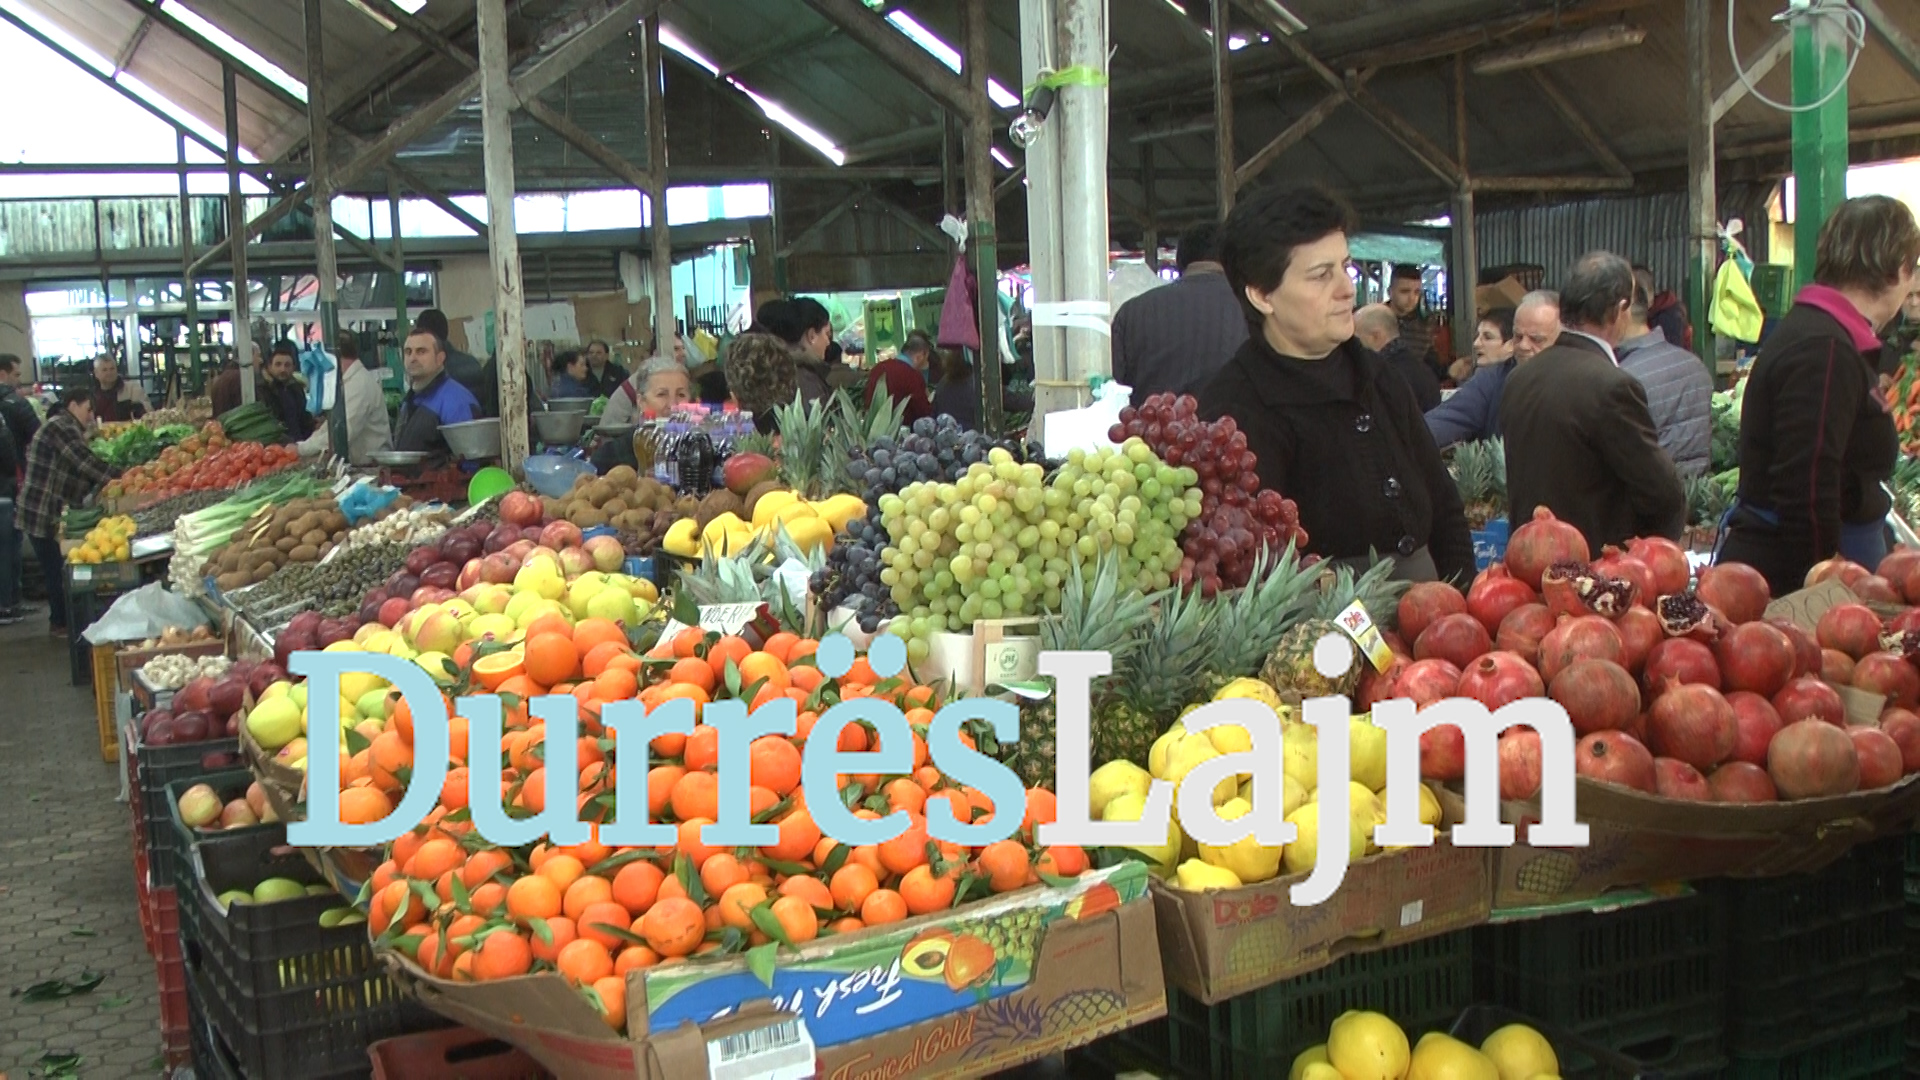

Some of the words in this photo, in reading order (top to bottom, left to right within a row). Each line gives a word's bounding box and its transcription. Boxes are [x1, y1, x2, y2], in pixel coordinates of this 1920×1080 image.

[1214, 893, 1279, 925] Dole
[812, 956, 903, 1019] Fresh
[921, 1013, 975, 1064] Gold
